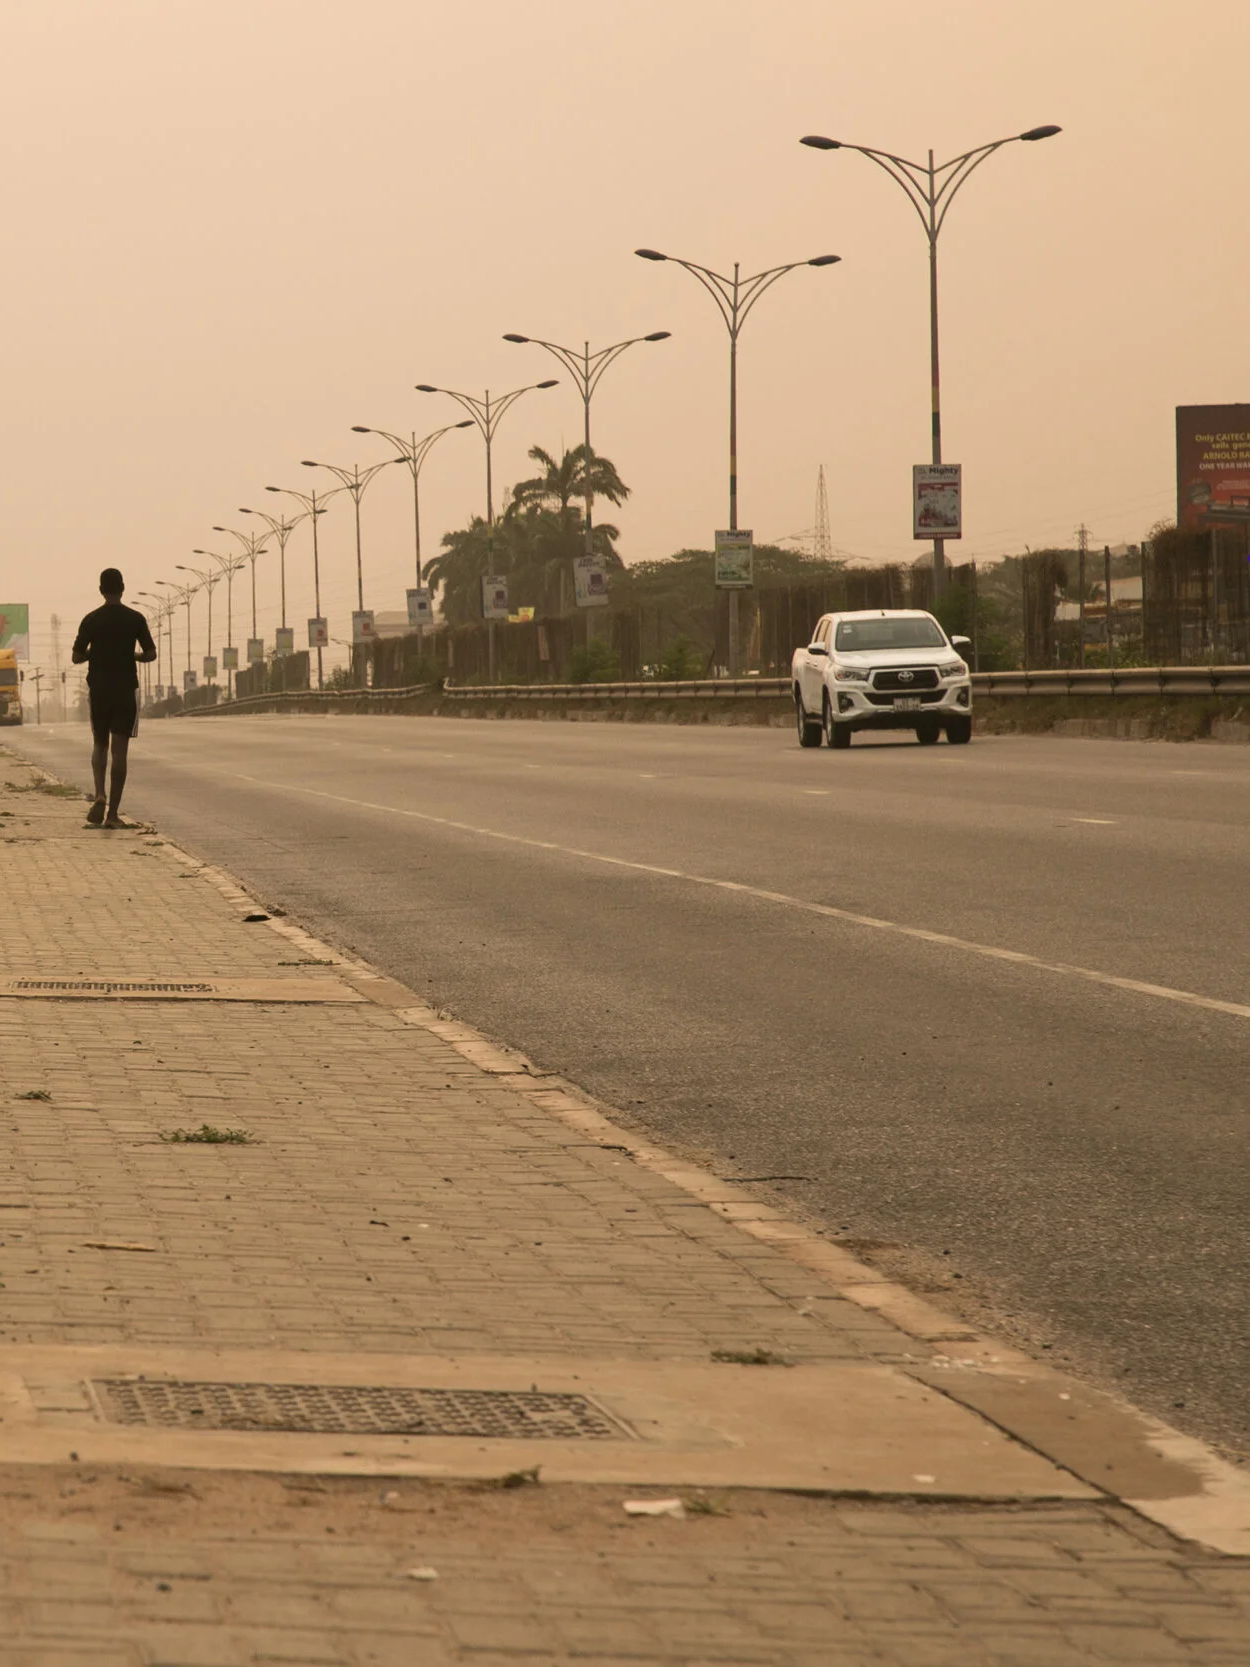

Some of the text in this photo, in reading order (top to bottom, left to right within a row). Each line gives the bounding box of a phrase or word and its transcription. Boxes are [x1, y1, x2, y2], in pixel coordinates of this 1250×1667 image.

[1195, 434, 1214, 442] Only
[1203, 452, 1238, 460] ARNOLD
[1199, 462, 1215, 470] ONE
[1216, 462, 1235, 470] YEAR
